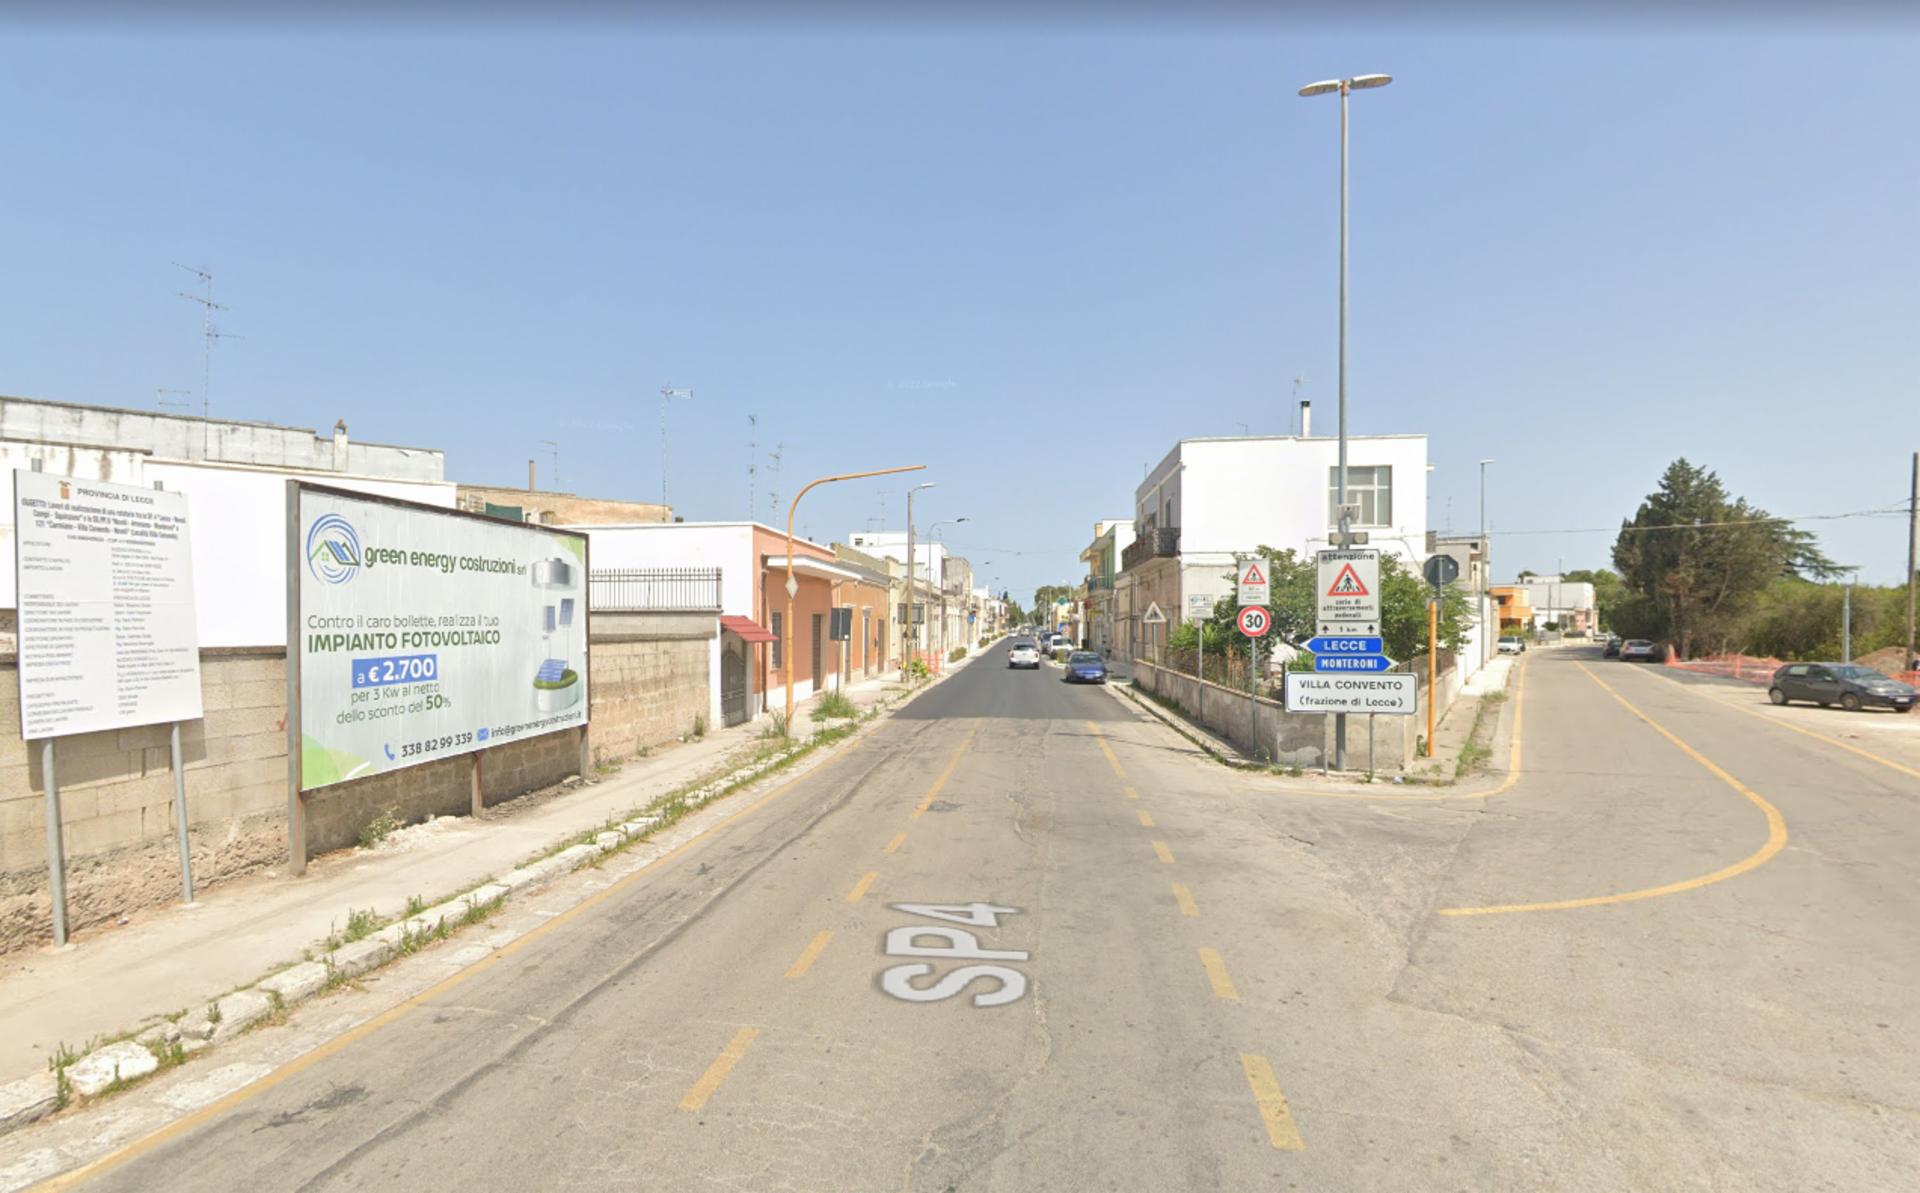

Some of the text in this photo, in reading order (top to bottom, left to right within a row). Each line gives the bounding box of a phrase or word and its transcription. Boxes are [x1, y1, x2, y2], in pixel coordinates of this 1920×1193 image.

[77, 488, 154, 506] PROVINCIA DI LECCE
[364, 546, 408, 569] green
[410, 551, 457, 573] energy
[459, 555, 516, 575] costruzioni
[1321, 552, 1375, 561] attenzione
[307, 615, 354, 629] Contro
[356, 615, 363, 628] il
[366, 616, 391, 629] caro
[393, 615, 437, 629] bollette,
[438, 614, 476, 628] realizza
[483, 614, 499, 627] tuo
[1245, 614, 1263, 628] 30
[308, 630, 501, 653] IMPIANTO FOTOVOLTAICO
[1323, 640, 1367, 651] LECCE
[356, 658, 434, 684] a € 2.700
[1321, 658, 1378, 669] MONTERONI
[1299, 680, 1403, 690] VILLA CONVENTO
[350, 682, 440, 706] per 3 Kw al netto
[1299, 695, 1404, 708] (frazione di Lecce)
[336, 693, 452, 725] dello sconto del 50%
[401, 742, 422, 758] 338
[425, 739, 438, 752] 82
[439, 736, 453, 749] 99
[455, 732, 473, 746] 339
